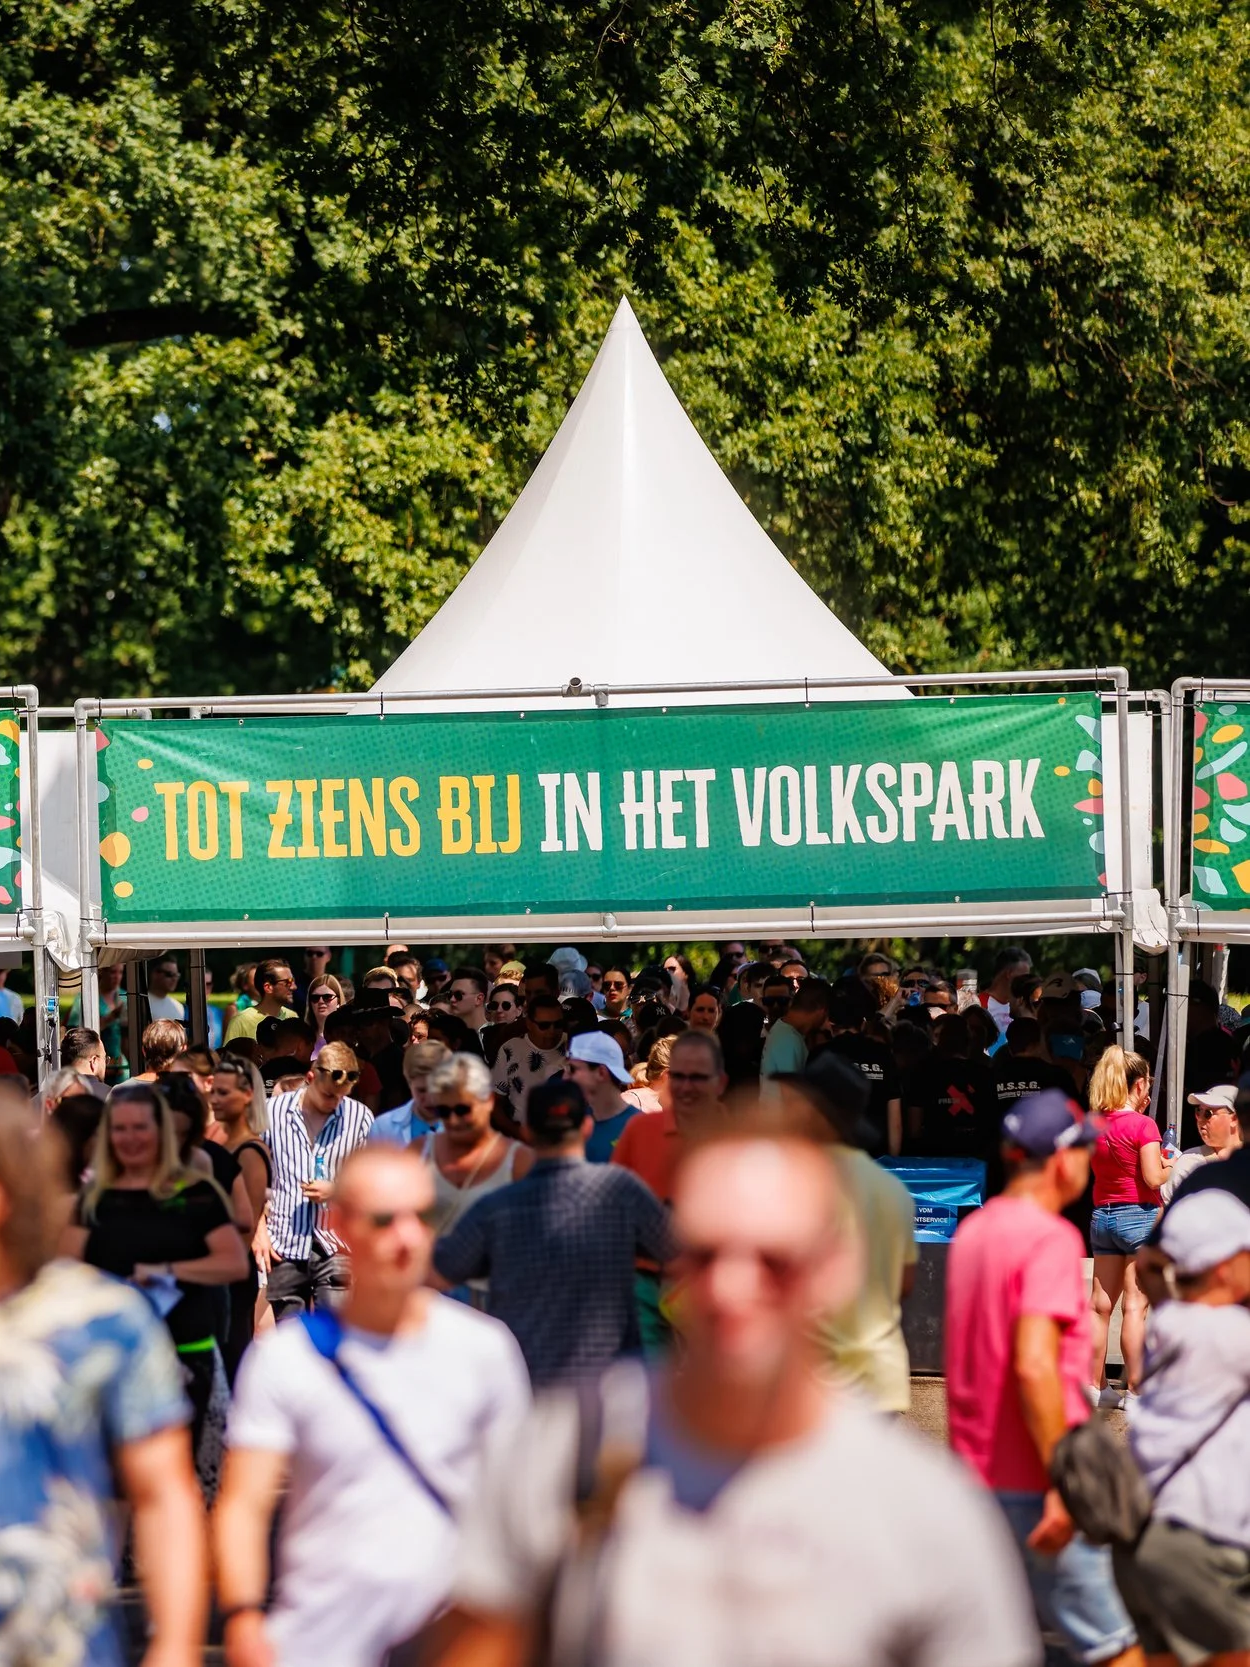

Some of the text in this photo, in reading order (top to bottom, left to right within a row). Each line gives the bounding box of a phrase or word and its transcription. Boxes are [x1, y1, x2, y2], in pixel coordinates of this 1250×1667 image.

[154, 758, 1046, 861] TOT ZIENS BIJ IN HET VOLKSPARK
[997, 1081, 1041, 1092] N.S.S.G.
[914, 1216, 948, 1224] NTSERVICE
